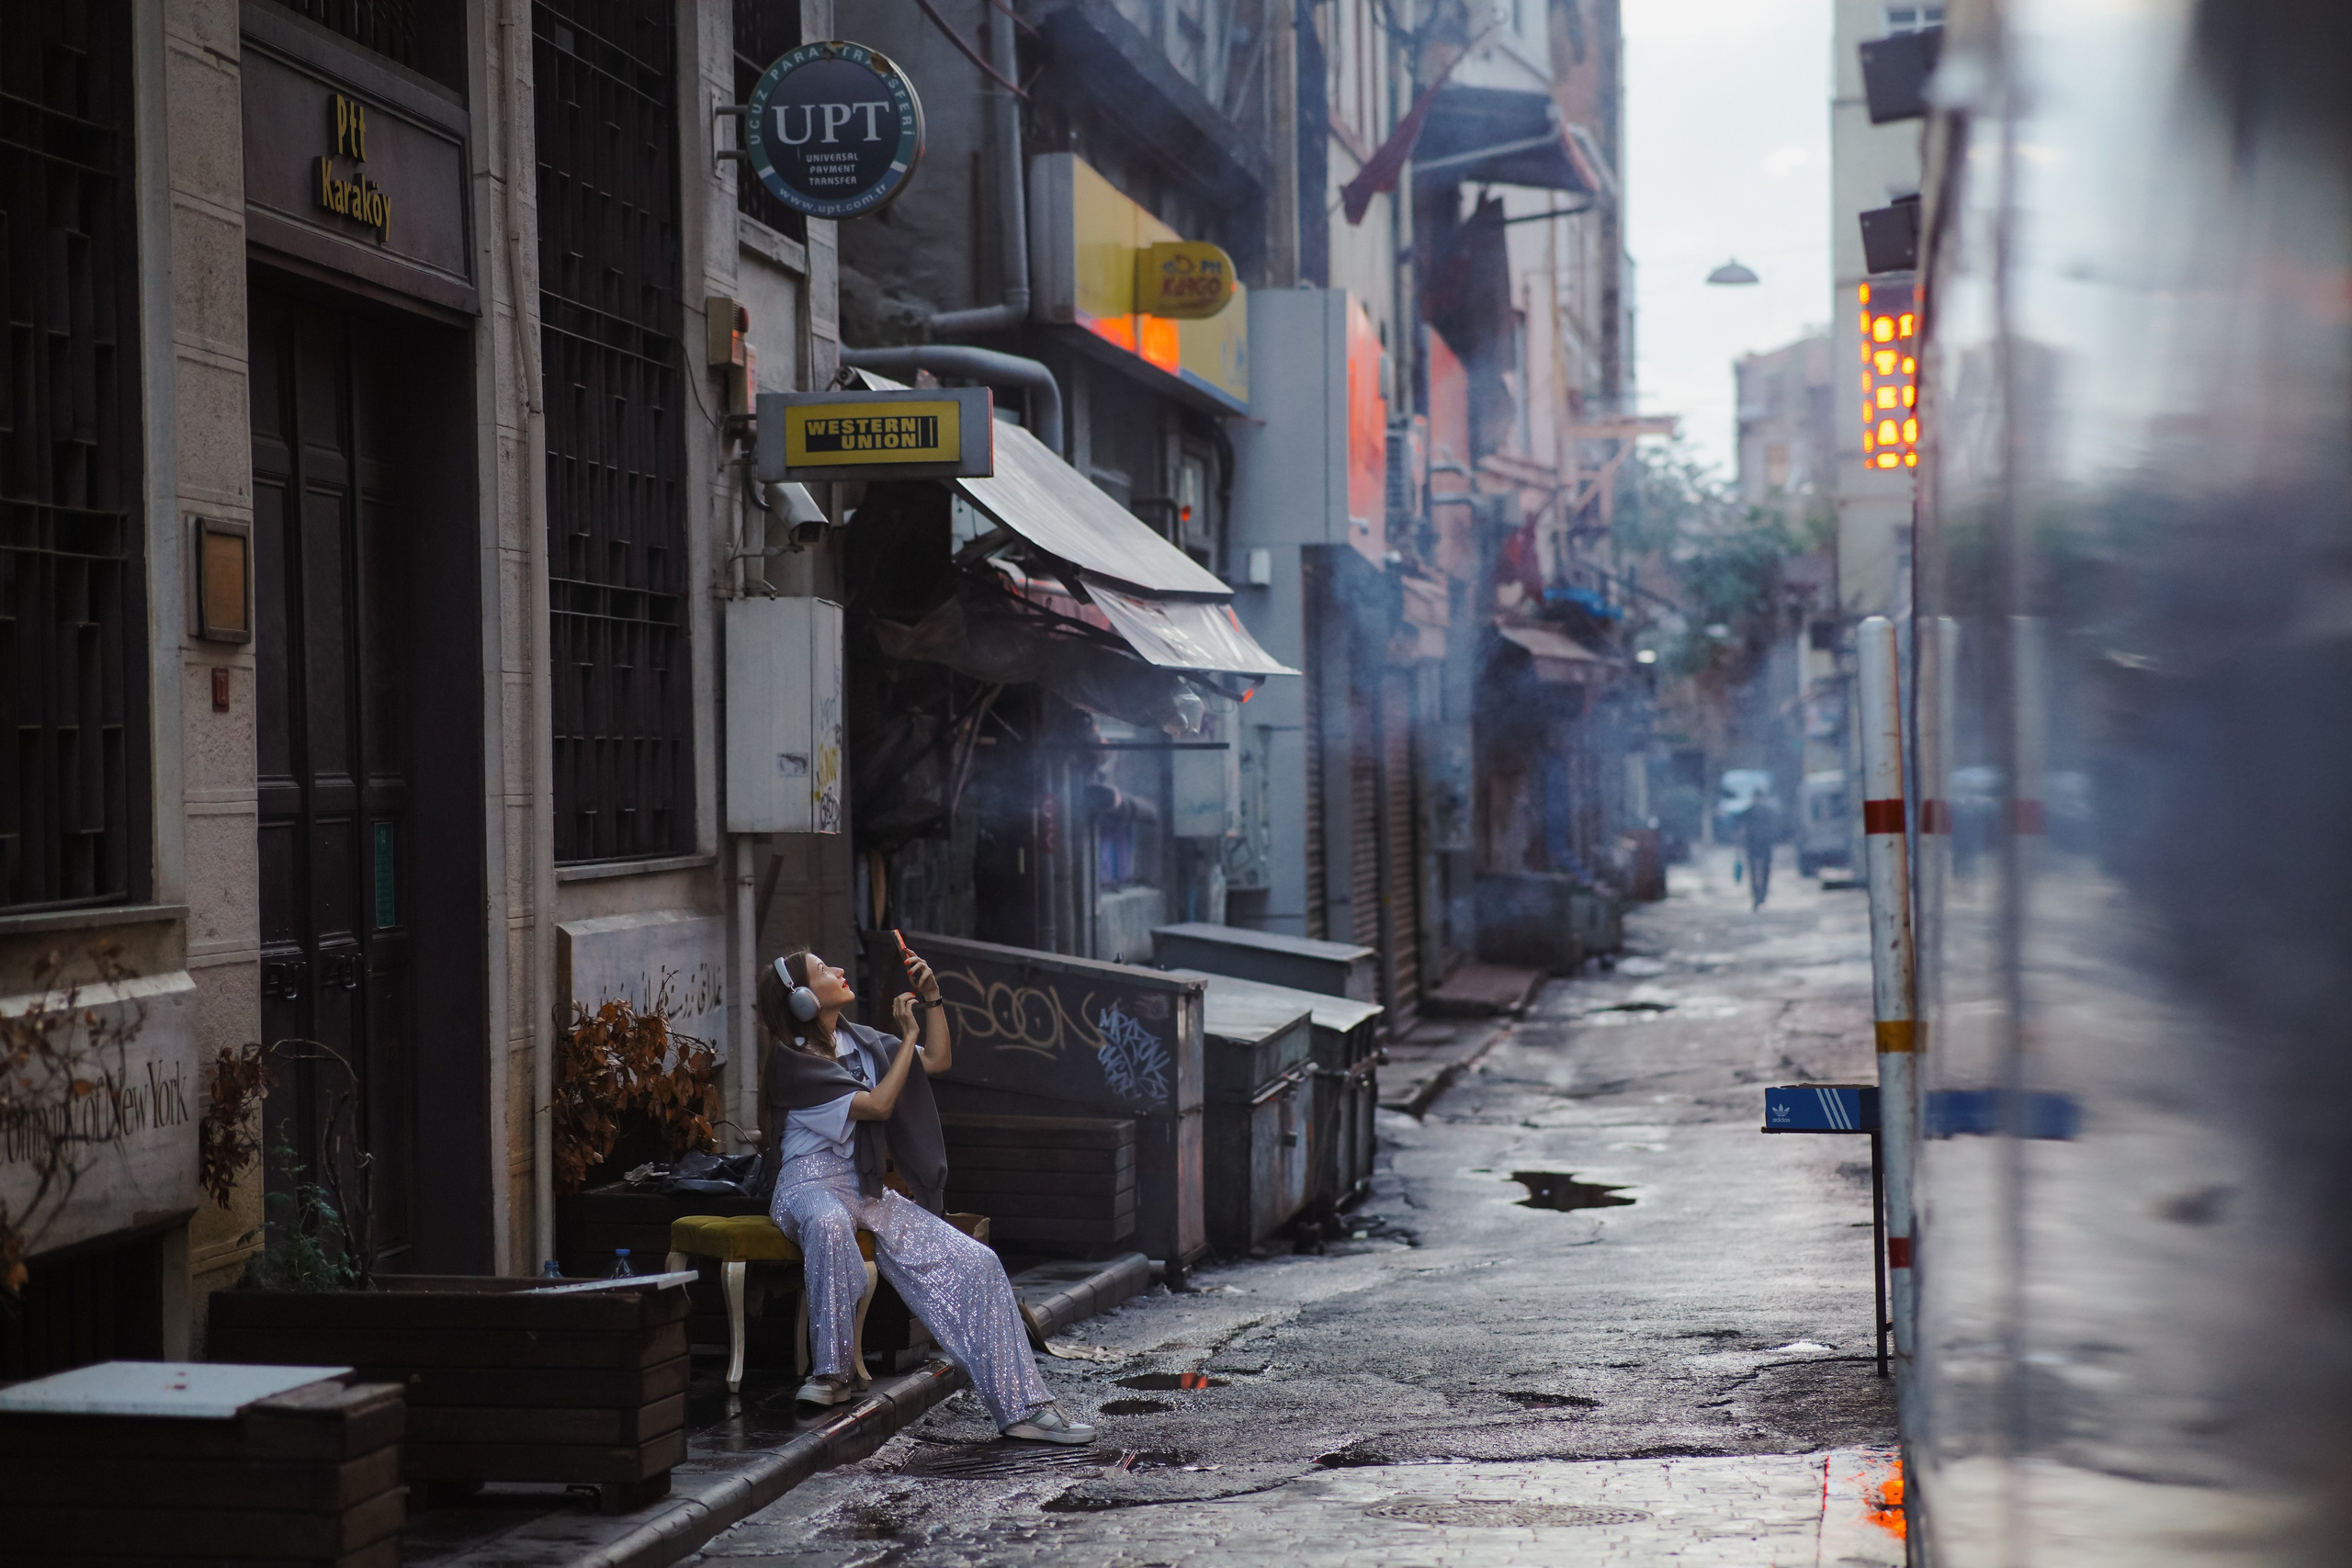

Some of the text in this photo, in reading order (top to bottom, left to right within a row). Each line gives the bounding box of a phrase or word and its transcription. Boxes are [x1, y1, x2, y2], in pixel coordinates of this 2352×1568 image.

[749, 89, 768, 145] UCUZ
[770, 47, 819, 80] PARA
[336, 94, 367, 162] Ptt
[771, 101, 889, 144] UPT
[807, 152, 858, 163] UNIVERSAL
[810, 164, 855, 175] PAYMENT
[809, 176, 857, 186] TRANSFER
[322, 156, 391, 243] Karaköy
[779, 183, 888, 215] www.upt.com.tr
[807, 418, 916, 435] WESTERN
[842, 434, 916, 449] UNION
[147, 1059, 189, 1129] York
